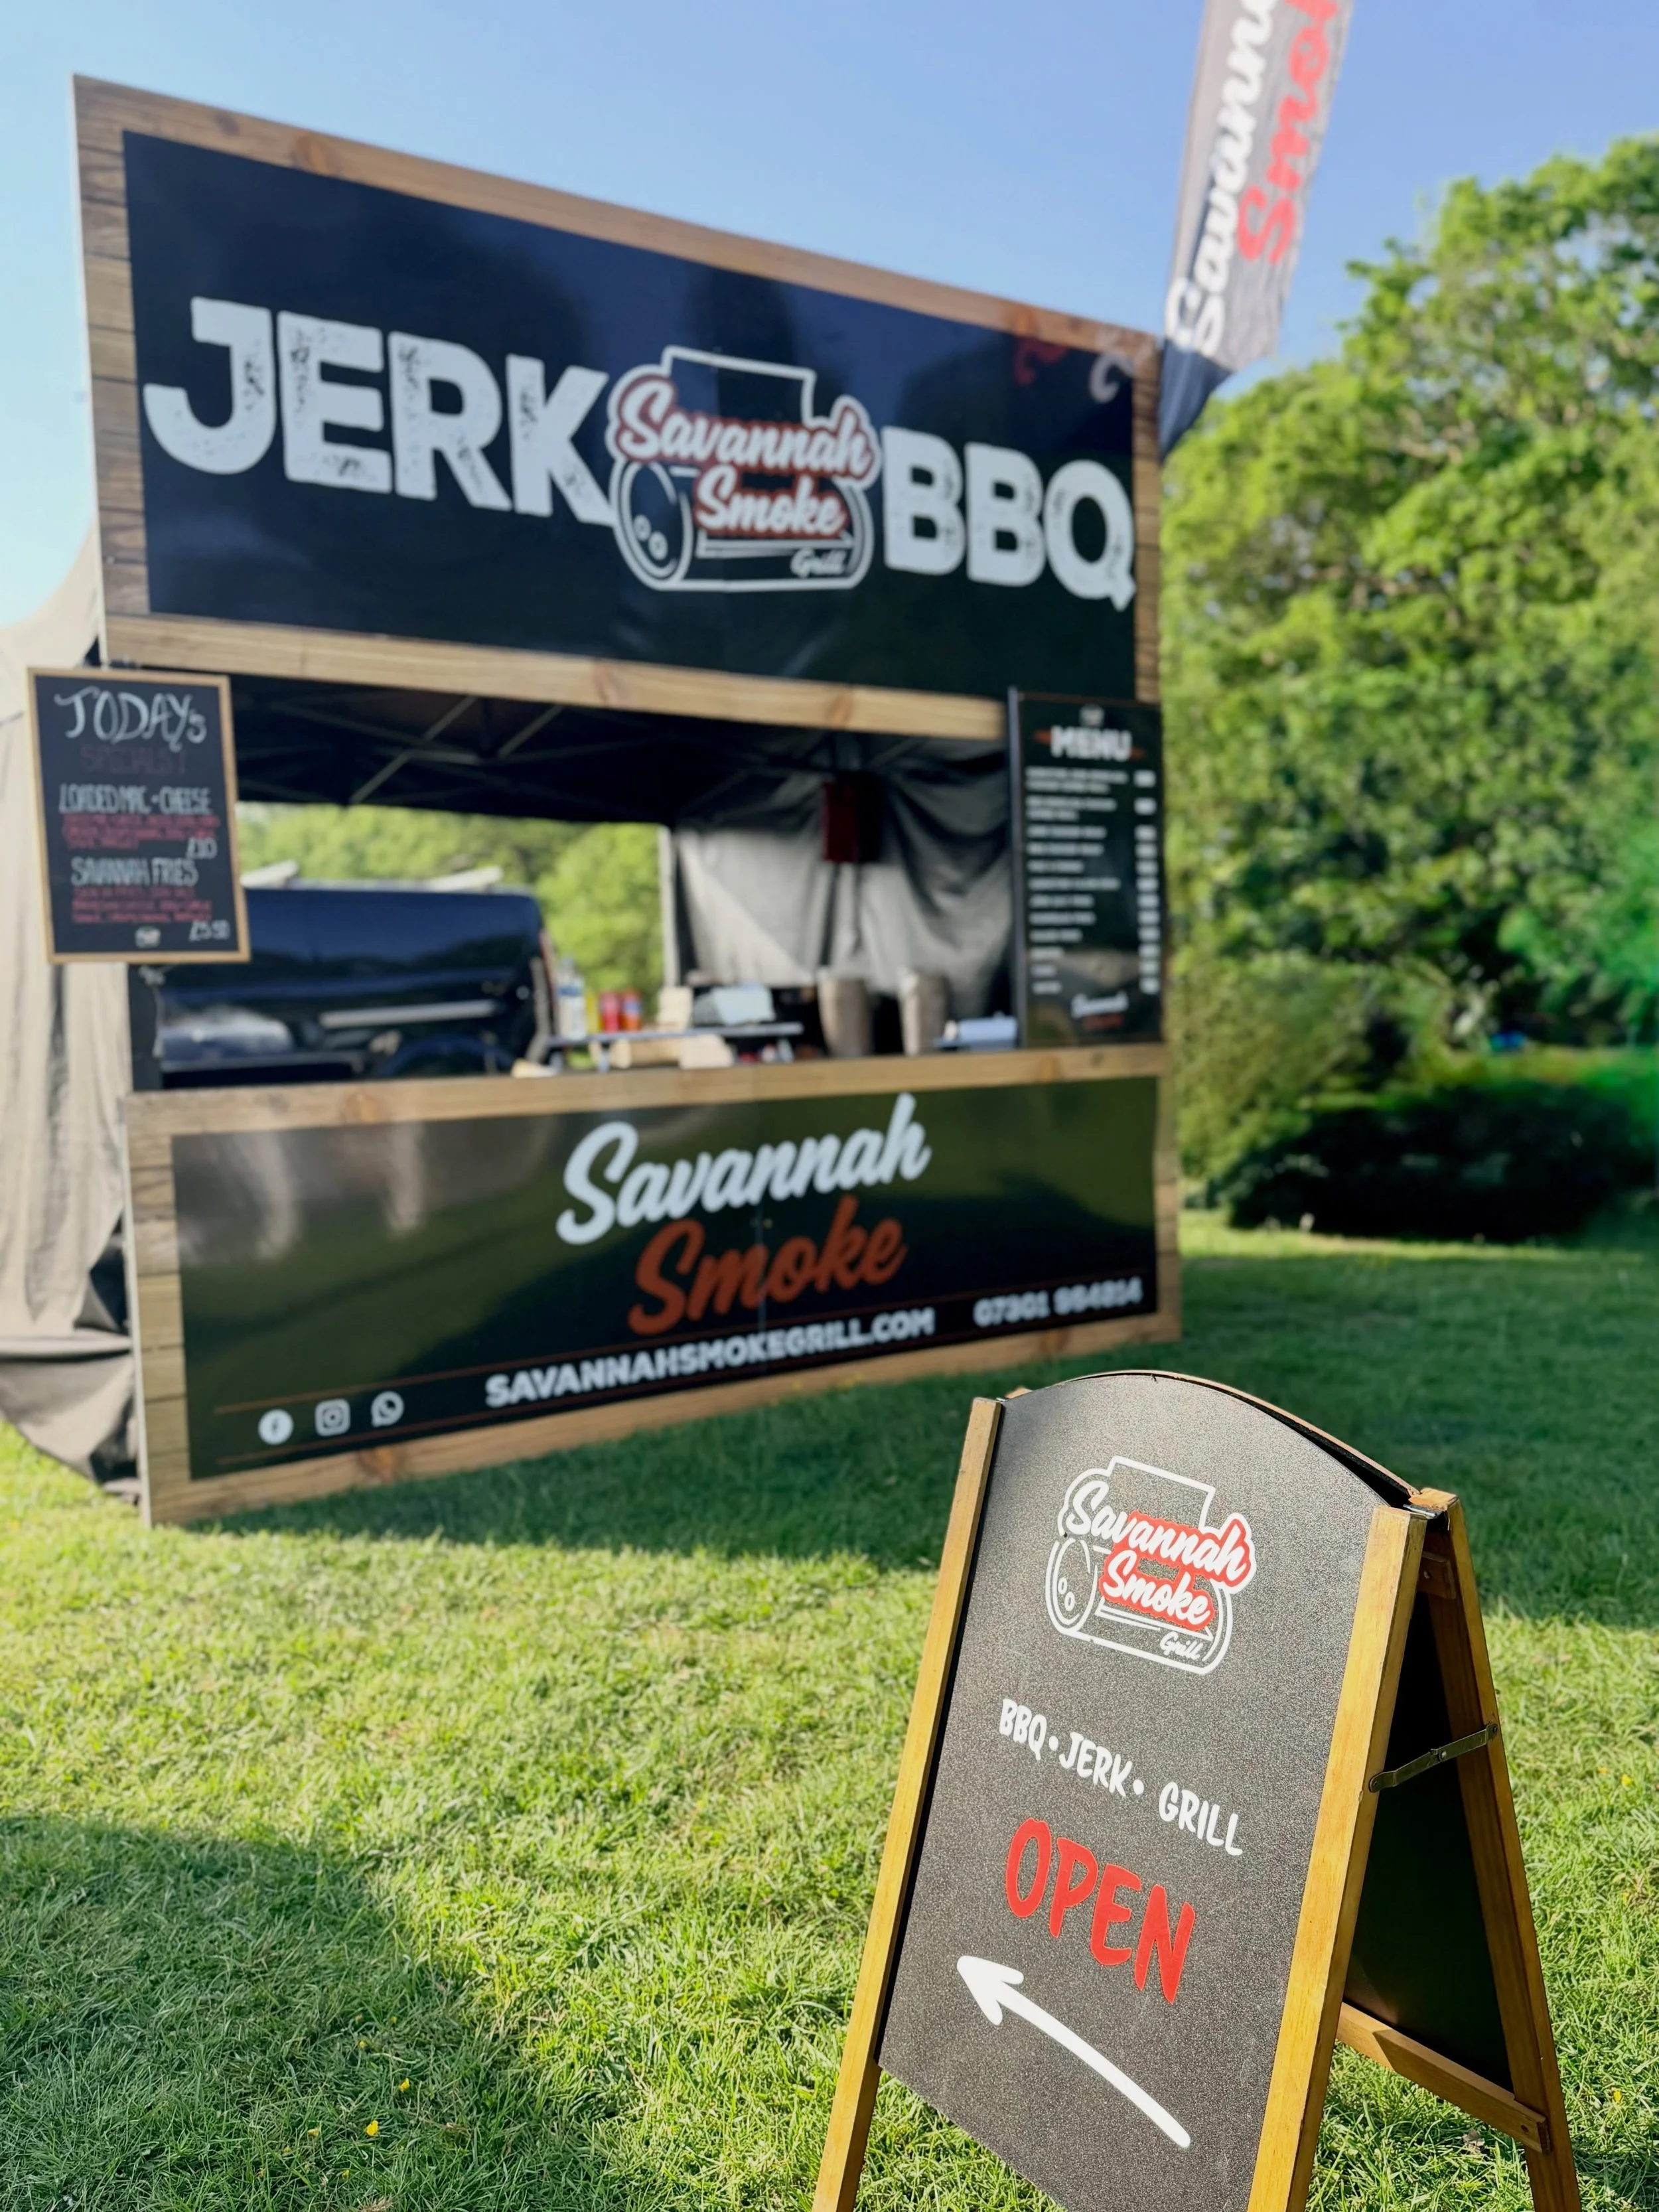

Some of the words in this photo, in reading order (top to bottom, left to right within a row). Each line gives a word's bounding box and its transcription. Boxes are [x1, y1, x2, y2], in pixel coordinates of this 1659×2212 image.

[1165, 0, 1273, 356] Savann
[143, 296, 617, 527] JERK
[618, 378, 875, 473] Savannah
[696, 464, 846, 532] Smoke
[881, 425, 1136, 612] BBQ
[790, 548, 847, 578] Grill
[1050, 725, 1132, 761] MENU
[151, 857, 198, 887] FRIES
[556, 1092, 931, 1245] Savannah
[628, 1195, 908, 1335] Smoke
[485, 1307, 936, 1408] SAVANNAHSMOKEGRILL.COM
[1066, 1481, 1248, 1581] Savannah
[1103, 1550, 1211, 1625] Smoke
[1160, 1633, 1204, 1659] Grill
[1159, 1781, 1243, 1856] GRILL
[1005, 1817, 1196, 2005] OPEN
